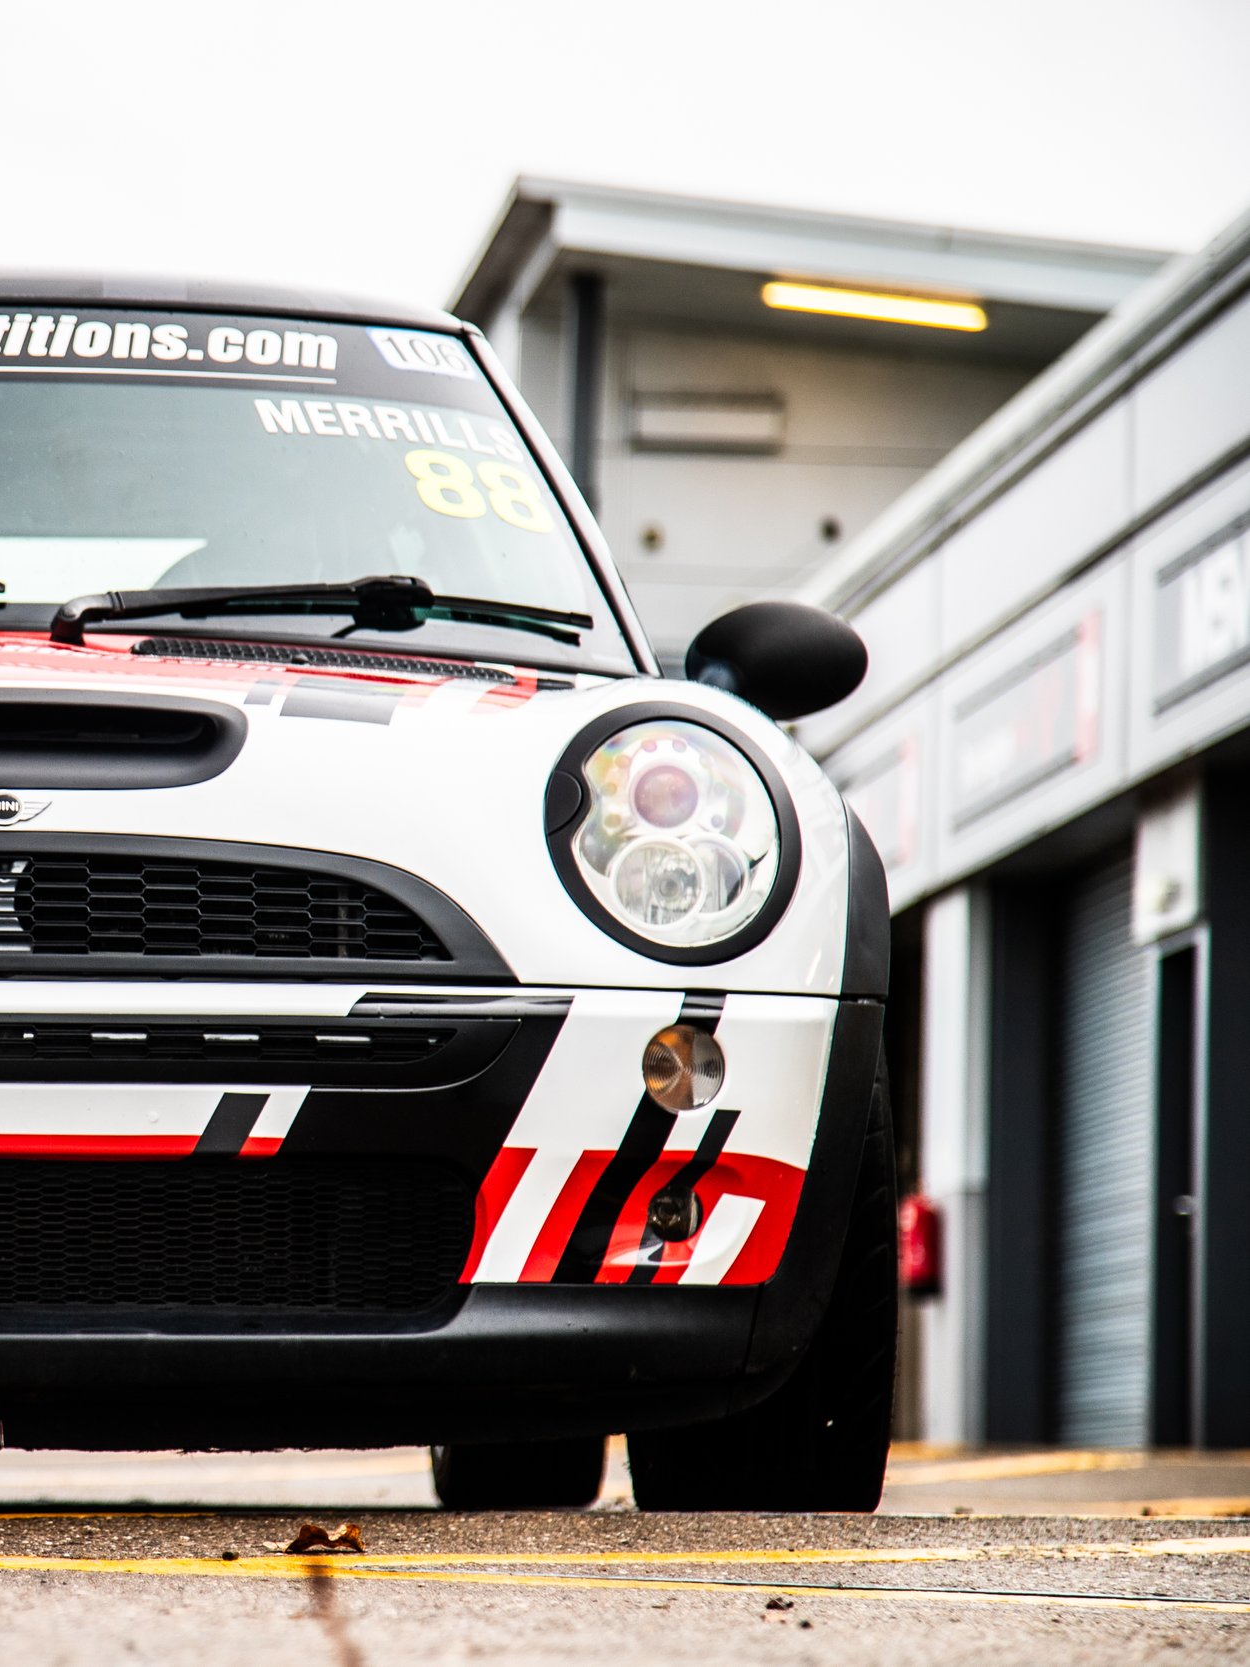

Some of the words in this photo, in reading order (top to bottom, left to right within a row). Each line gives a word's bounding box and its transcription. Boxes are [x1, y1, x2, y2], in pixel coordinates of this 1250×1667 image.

[381, 335, 468, 372] 106
[253, 399, 524, 464] MERRILLS
[404, 449, 554, 534] 88
